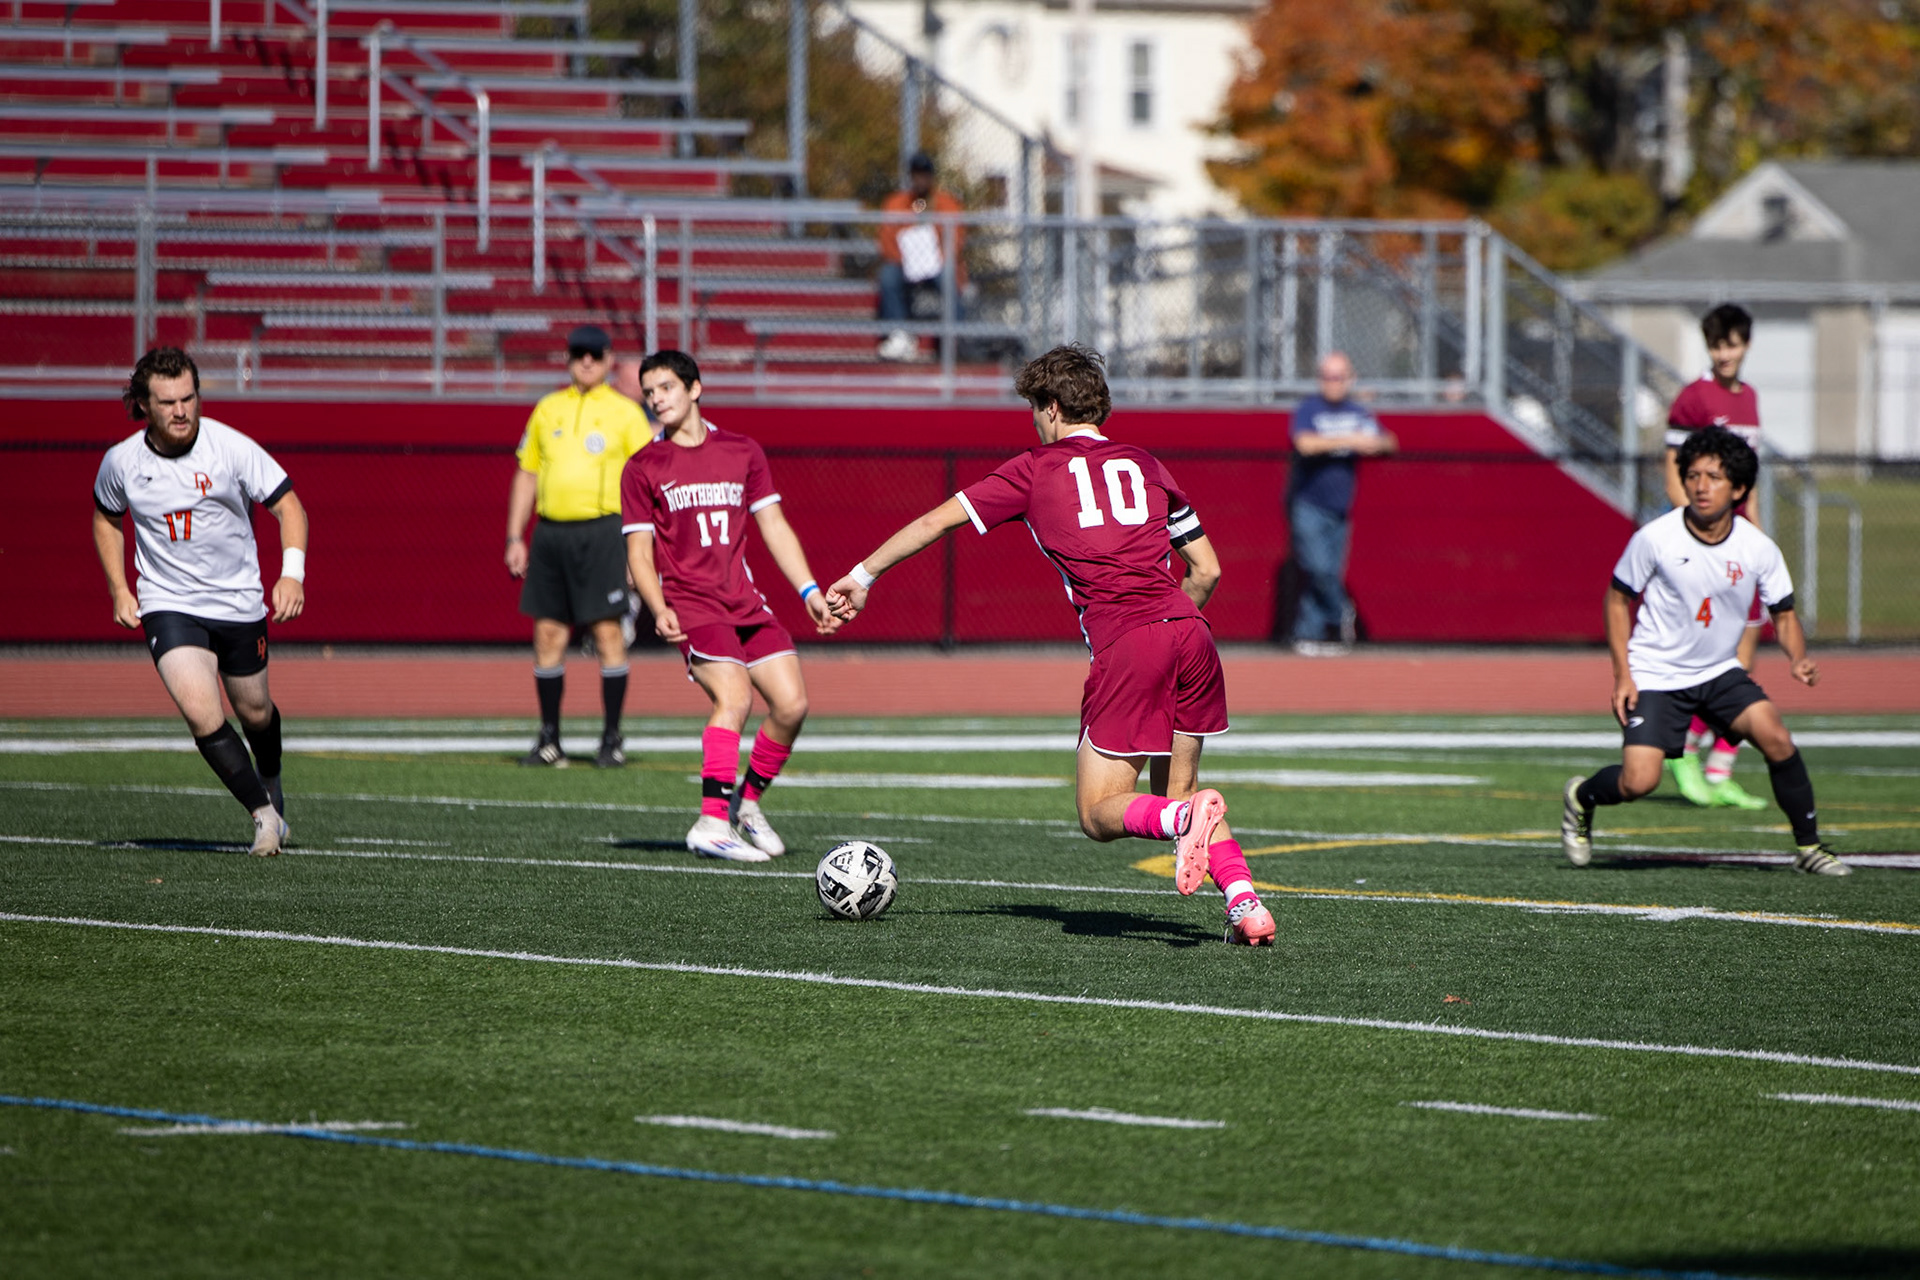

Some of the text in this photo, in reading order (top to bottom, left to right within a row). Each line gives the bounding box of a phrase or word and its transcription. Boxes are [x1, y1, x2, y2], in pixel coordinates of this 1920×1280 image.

[1068, 457, 1149, 529] 10
[163, 509, 192, 542] 17
[697, 510, 730, 547] 17
[1695, 597, 1713, 628] 4
